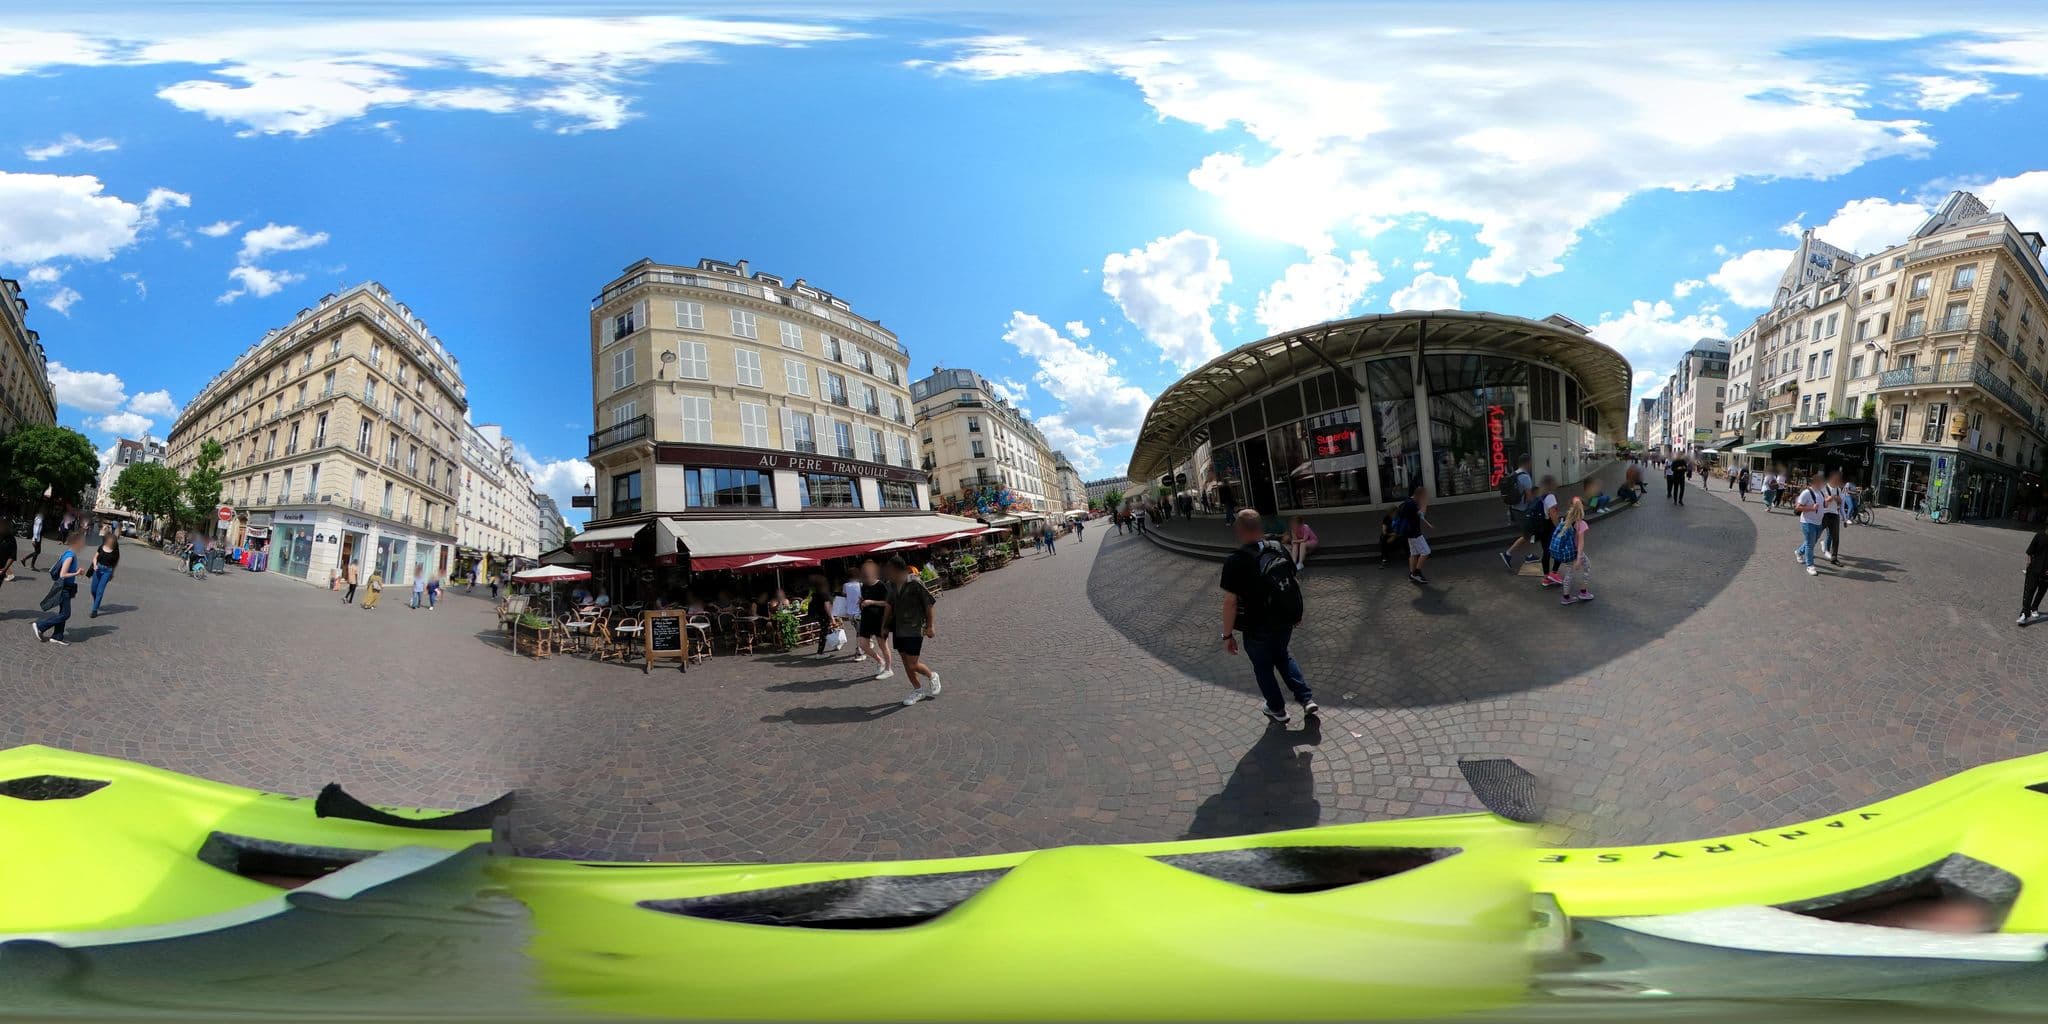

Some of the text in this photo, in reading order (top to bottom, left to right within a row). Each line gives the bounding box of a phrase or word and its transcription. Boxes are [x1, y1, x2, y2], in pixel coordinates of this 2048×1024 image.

[1317, 430, 1357, 444] Superdry
[1487, 405, 1507, 487] Superdry
[759, 455, 889, 477] AU PERE TRANQUILLE
